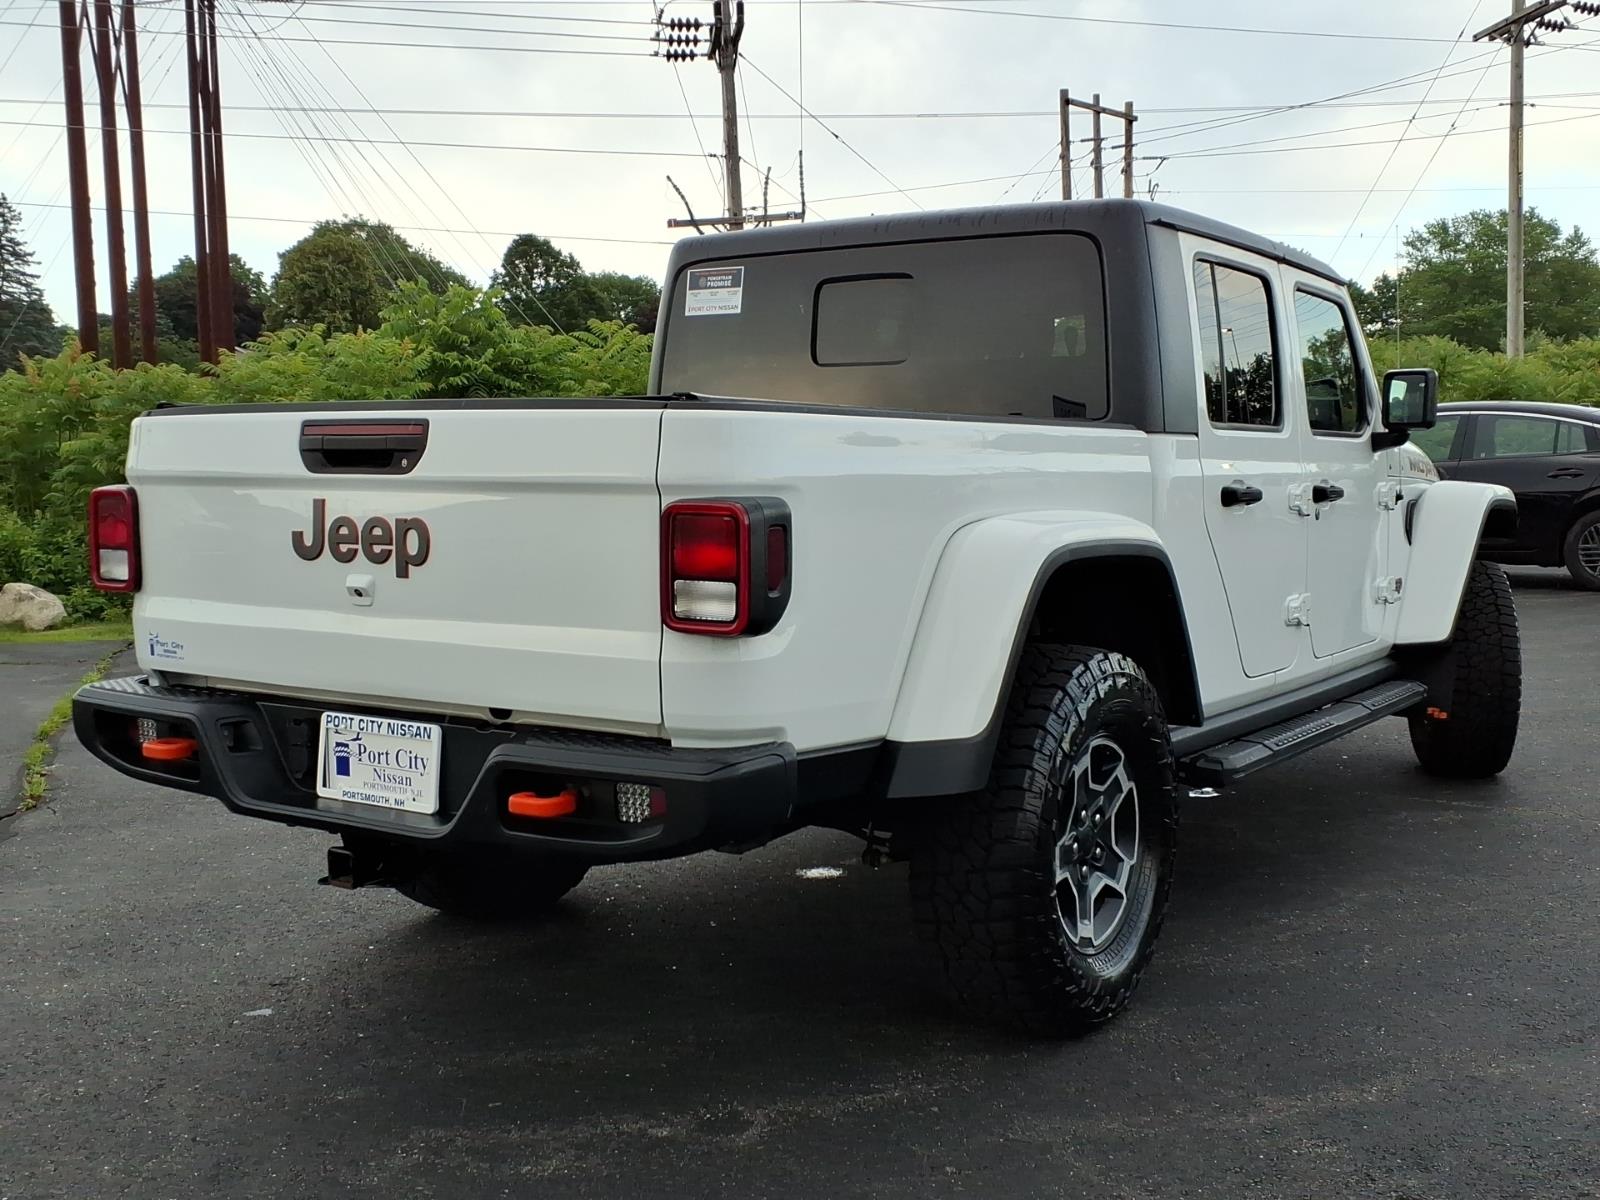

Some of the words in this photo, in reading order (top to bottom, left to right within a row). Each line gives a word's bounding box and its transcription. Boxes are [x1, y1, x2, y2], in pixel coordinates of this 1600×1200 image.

[291, 498, 431, 579] Jeep
[358, 718, 383, 733] CITY
[387, 722, 432, 739] NISSAN
[357, 743, 391, 767] Port
[395, 748, 429, 777] City
[373, 767, 412, 787] Nissan
[394, 799, 405, 807] NH
